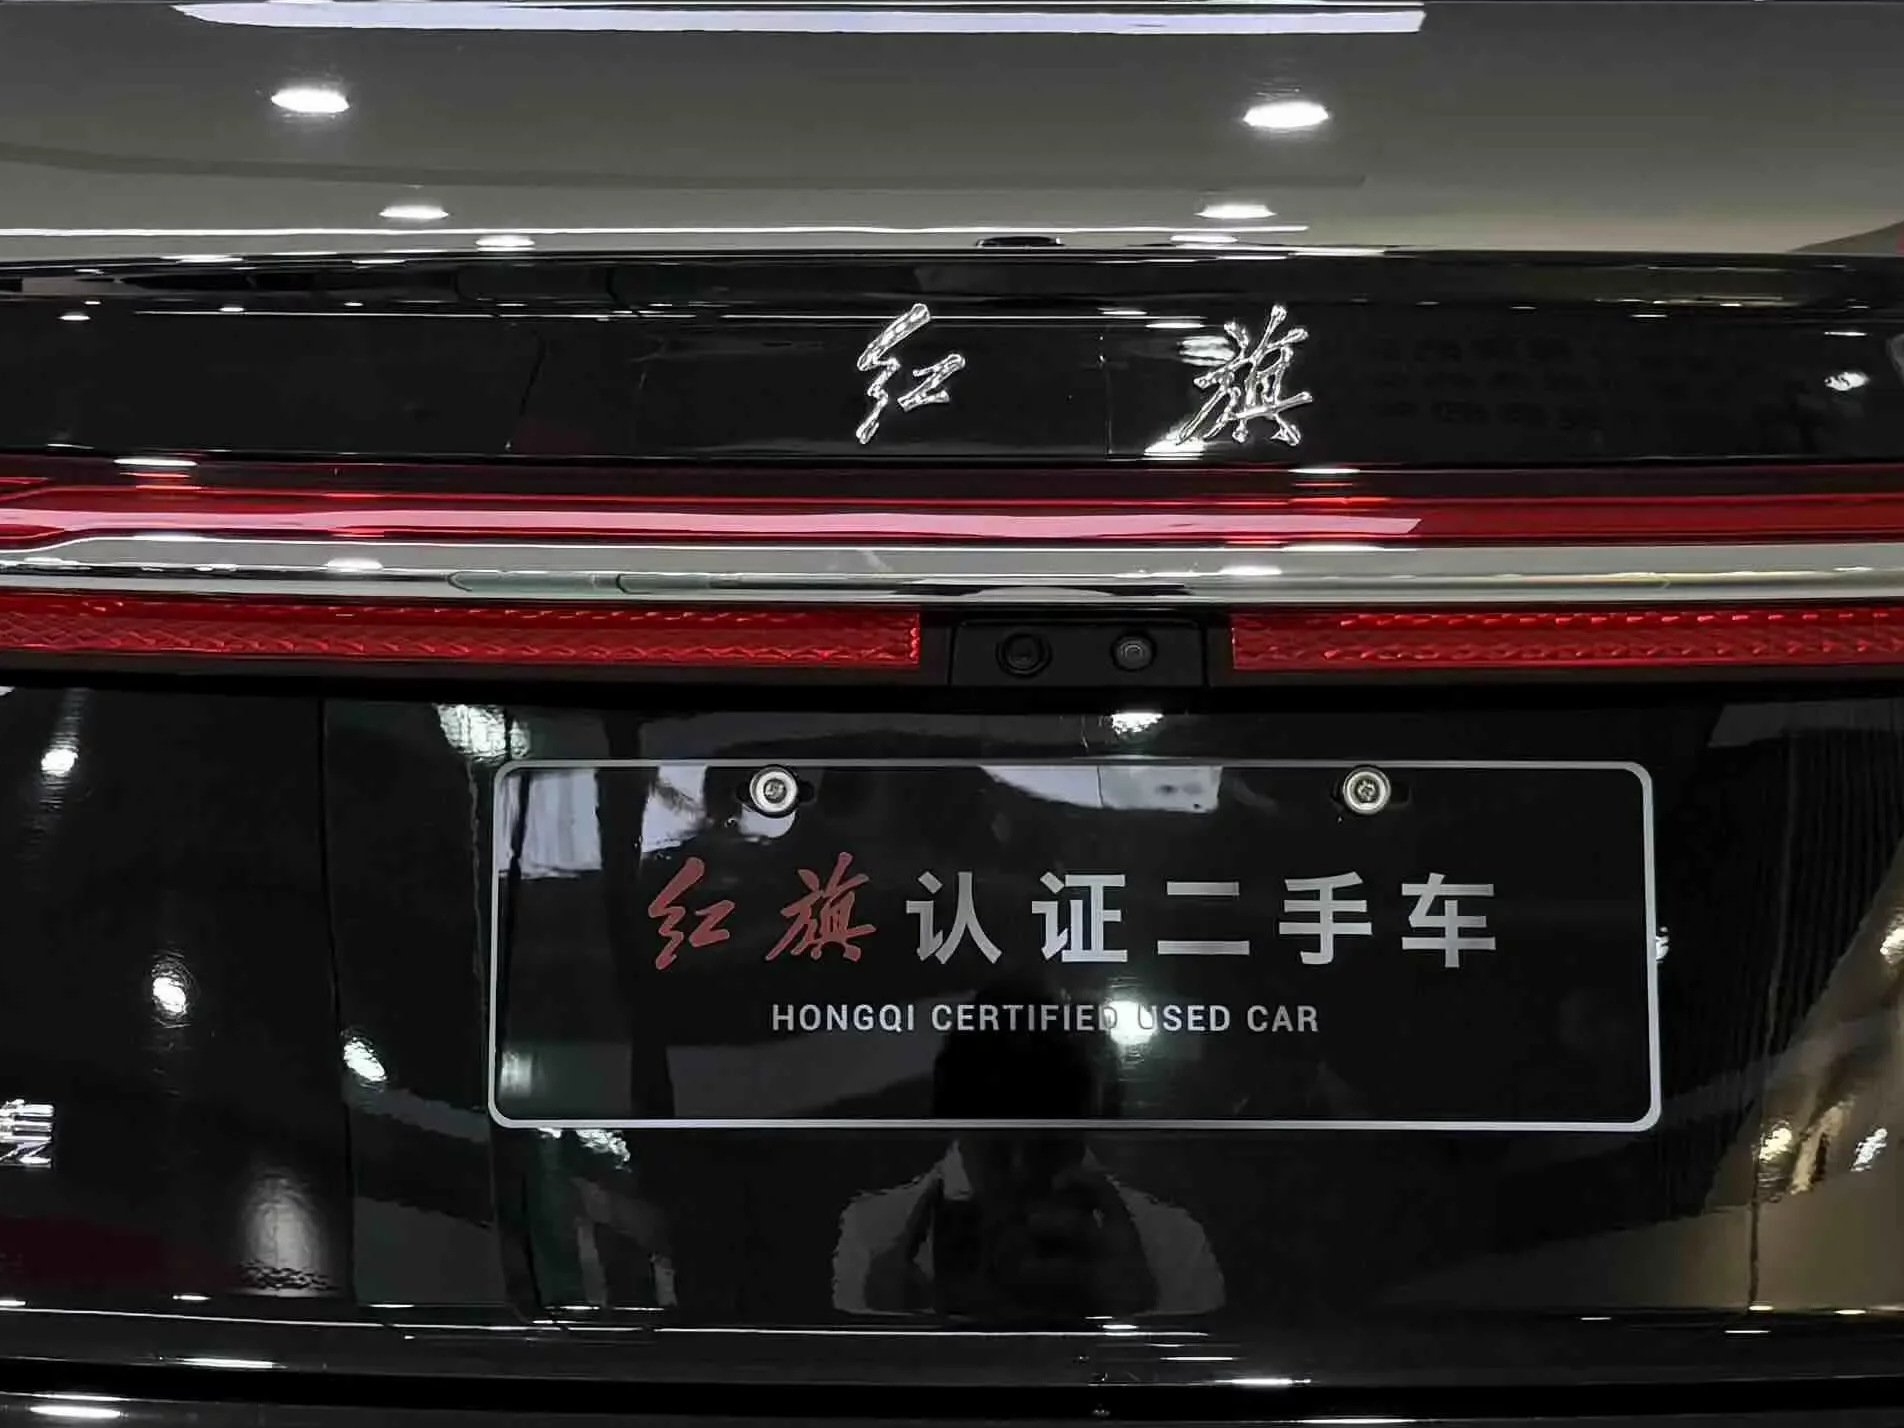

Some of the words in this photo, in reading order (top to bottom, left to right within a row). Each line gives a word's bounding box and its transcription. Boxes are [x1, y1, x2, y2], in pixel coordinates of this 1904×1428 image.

[855, 302, 1315, 445] 红旗
[771, 1002, 918, 1035] HONGQI
[931, 1002, 1119, 1035] CERTIFIED
[1135, 1002, 1236, 1035] USED
[1246, 1002, 1321, 1035] CAR
